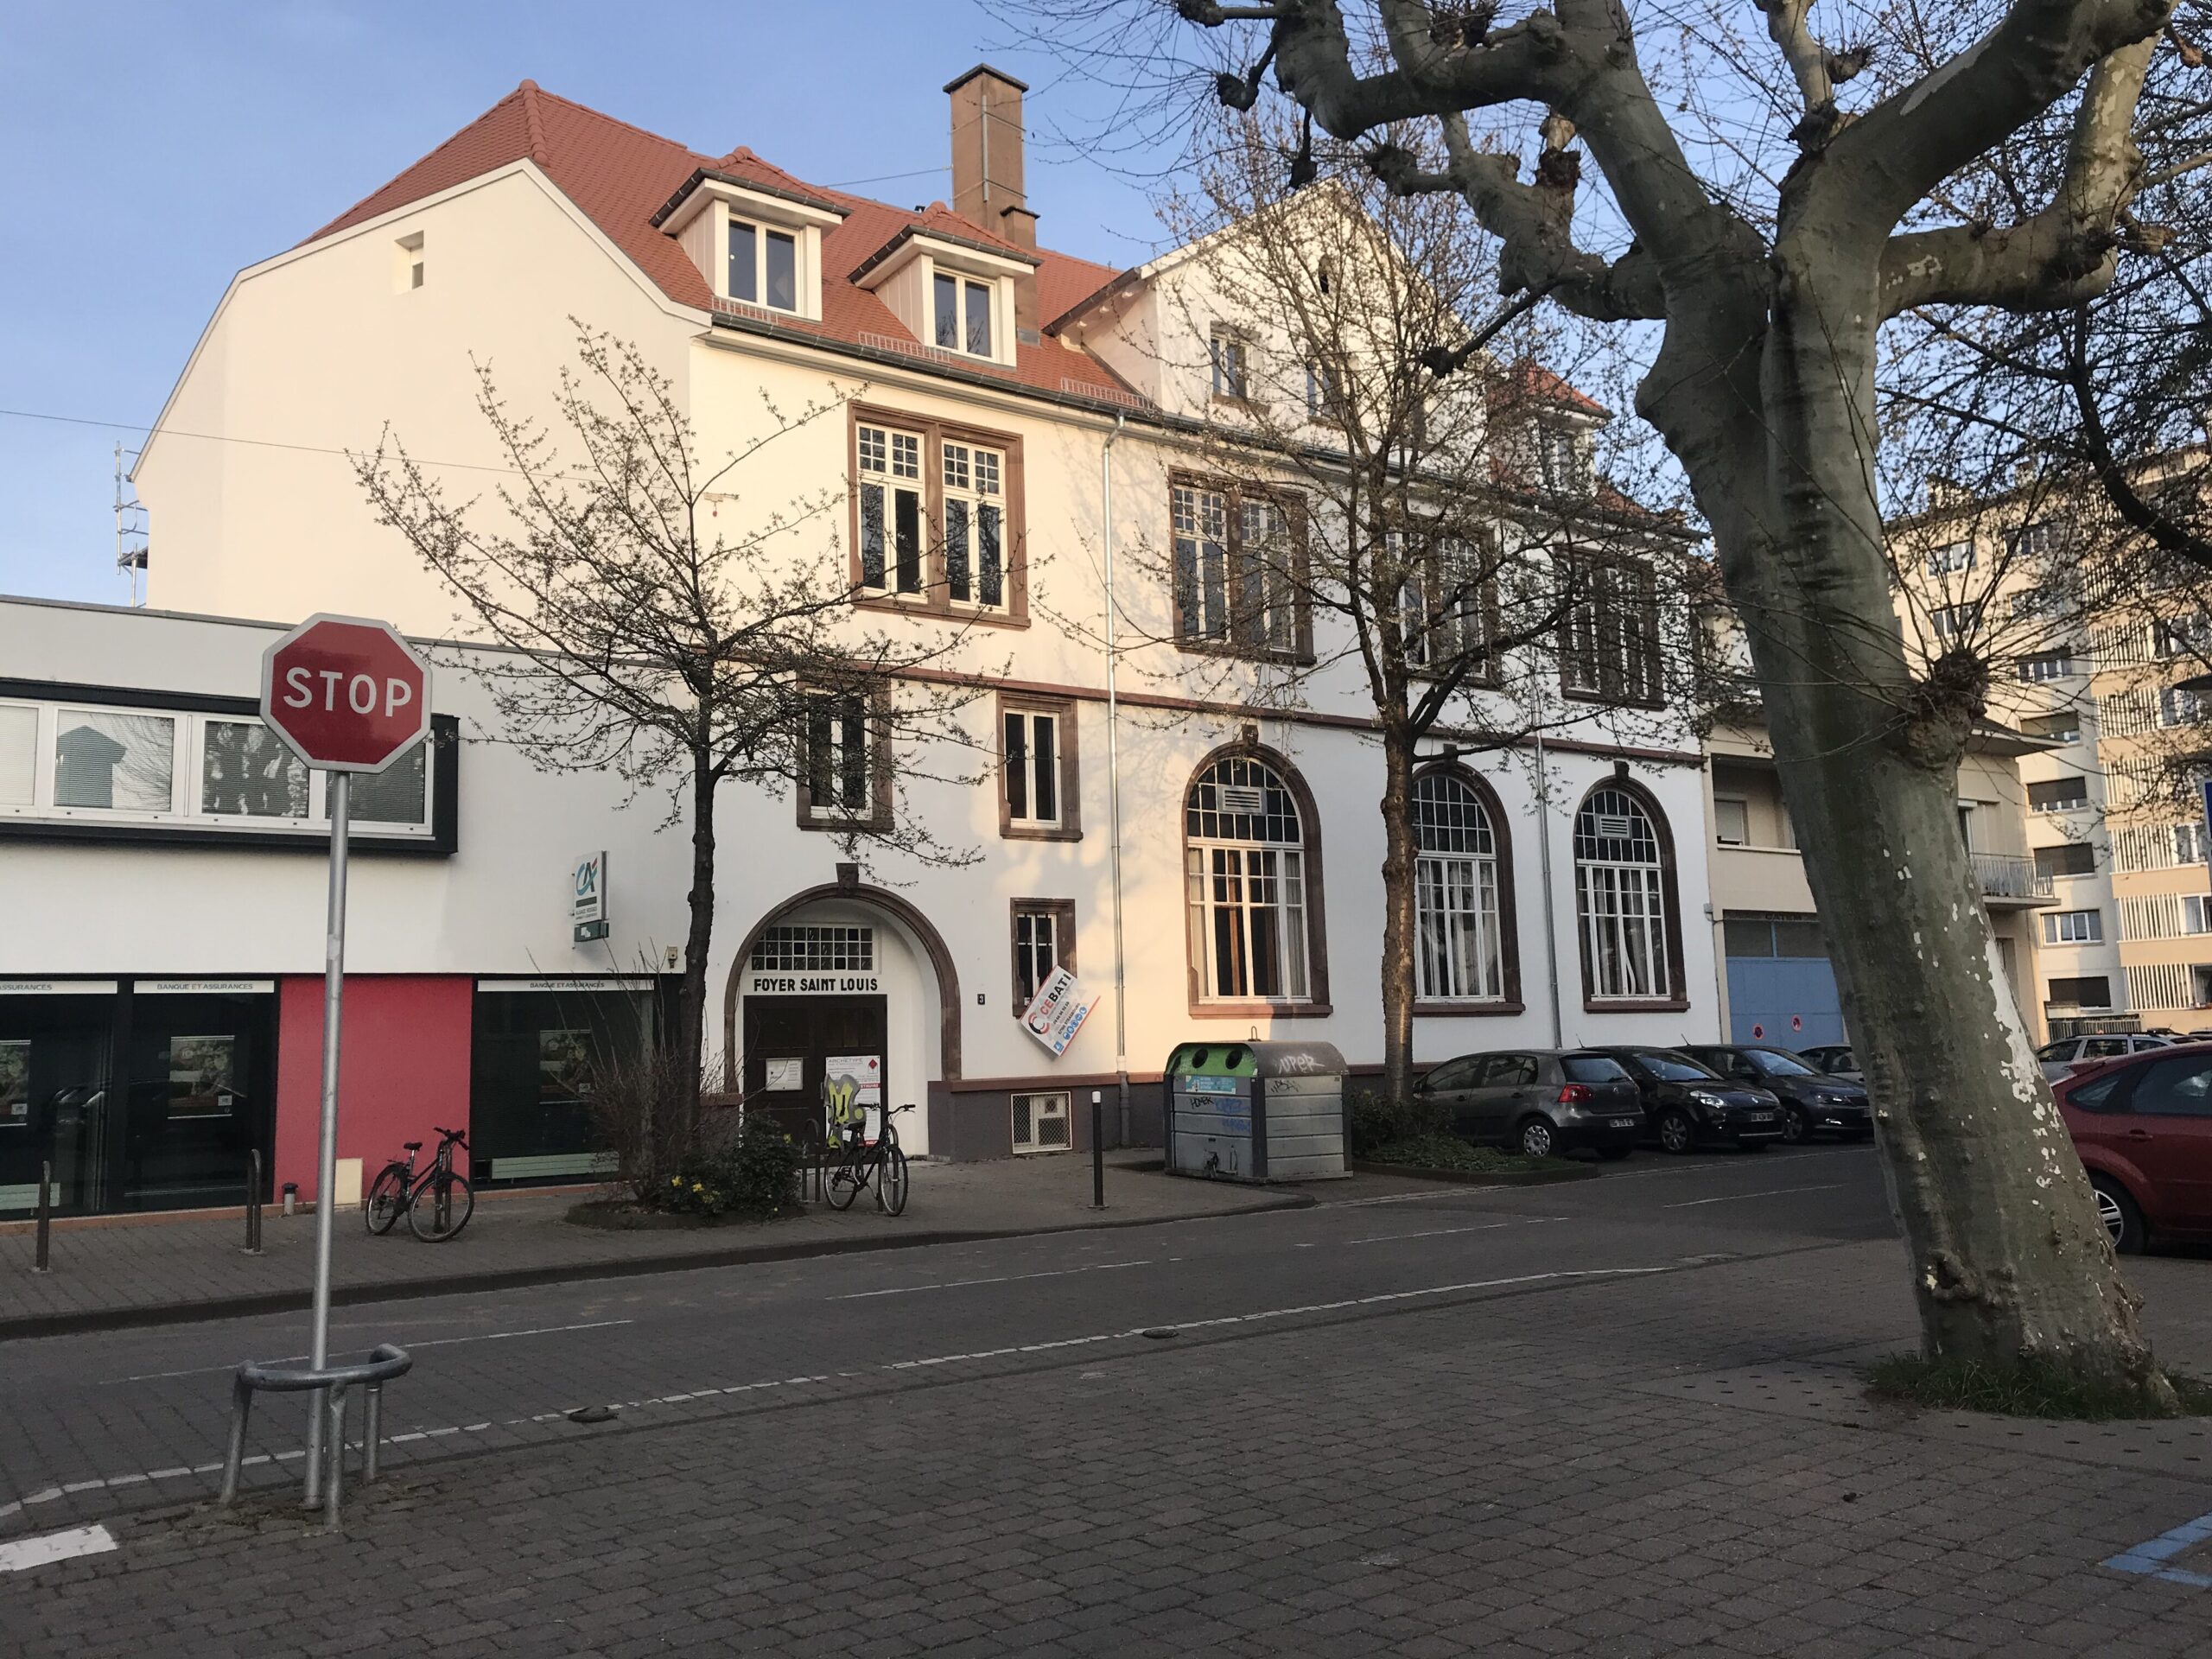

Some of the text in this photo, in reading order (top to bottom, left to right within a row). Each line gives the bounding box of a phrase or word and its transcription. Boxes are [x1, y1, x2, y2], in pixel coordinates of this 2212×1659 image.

[283, 667, 411, 717] STOP
[753, 978, 878, 992] FOYER SAINT LOUIS
[1039, 973, 1071, 1016] CEBATI
